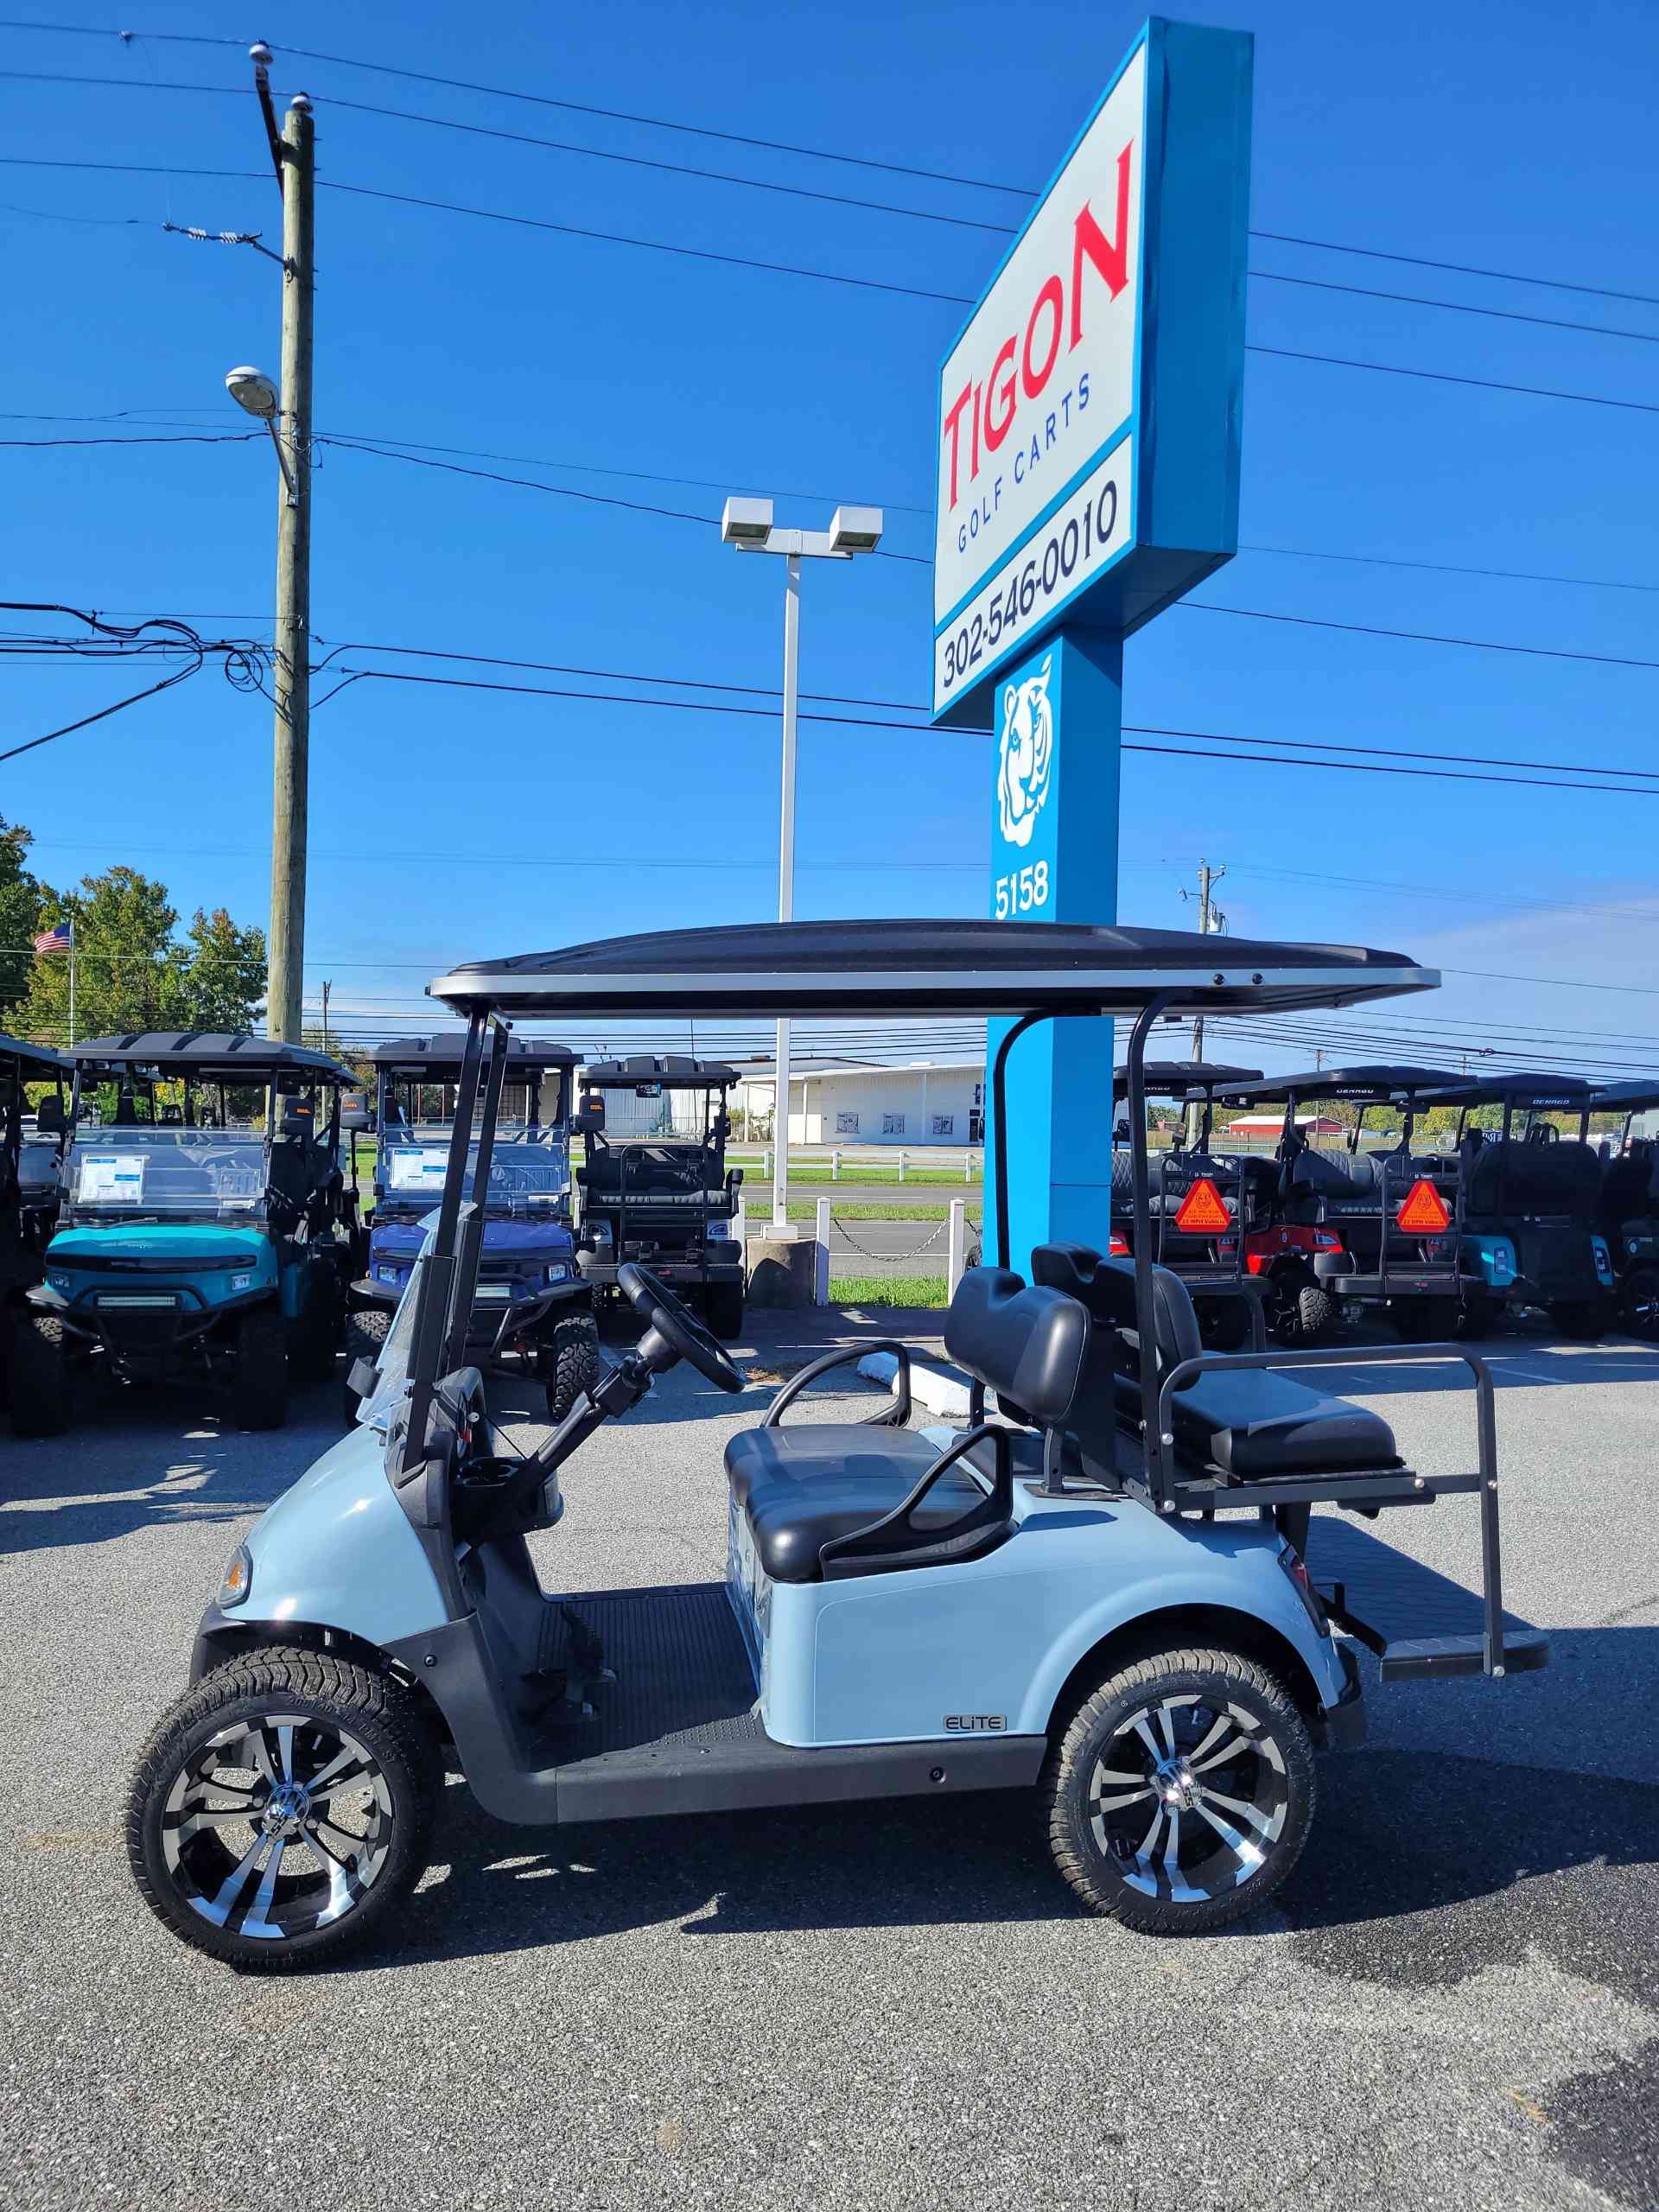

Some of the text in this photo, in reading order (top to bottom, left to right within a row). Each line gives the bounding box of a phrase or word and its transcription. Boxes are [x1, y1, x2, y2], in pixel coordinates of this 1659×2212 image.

[944, 137, 1135, 512] TIGON
[957, 372, 1090, 554] GOLF CARTS
[944, 480, 1118, 688] 302-546-0010
[995, 860, 1049, 921] 5158
